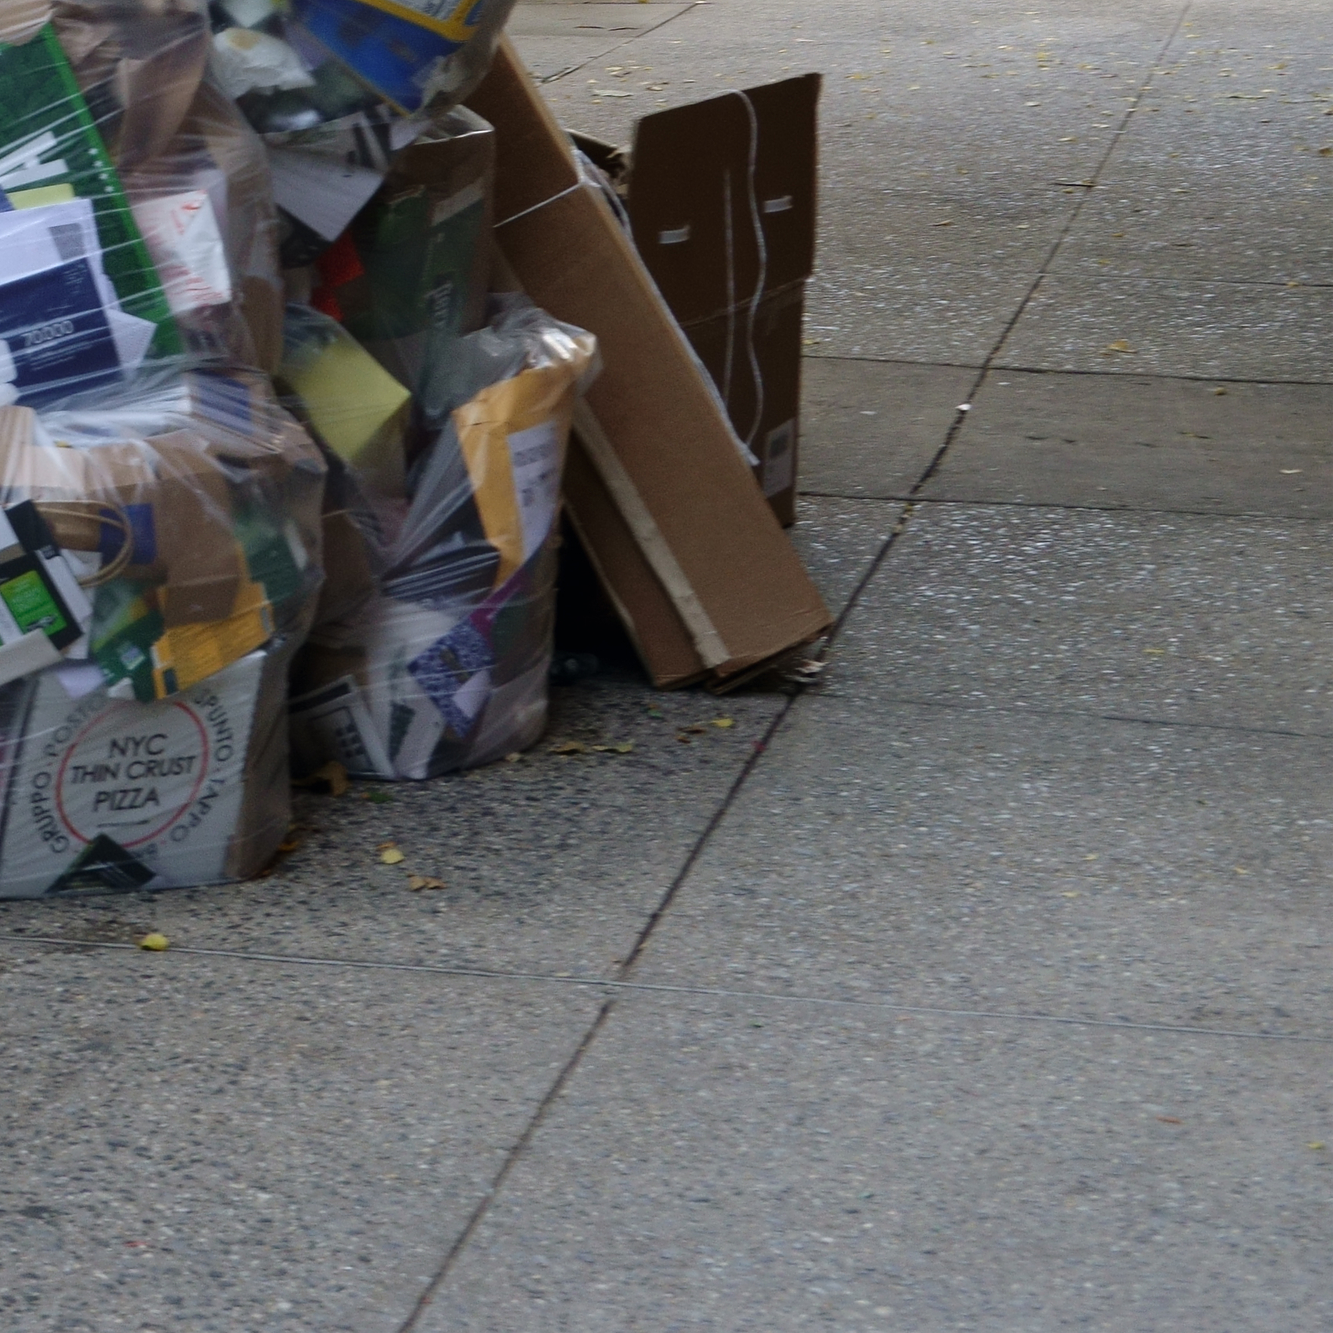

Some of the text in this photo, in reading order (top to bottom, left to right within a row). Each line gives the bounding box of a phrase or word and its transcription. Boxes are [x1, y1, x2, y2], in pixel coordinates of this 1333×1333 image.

[108, 732, 169, 759] NYC
[193, 688, 234, 763] SPUNTO
[70, 755, 197, 795] THIN CRUST
[92, 787, 161, 812] PIZZA
[29, 770, 71, 854] GRUPPO
[169, 777, 225, 843] TAPPO
